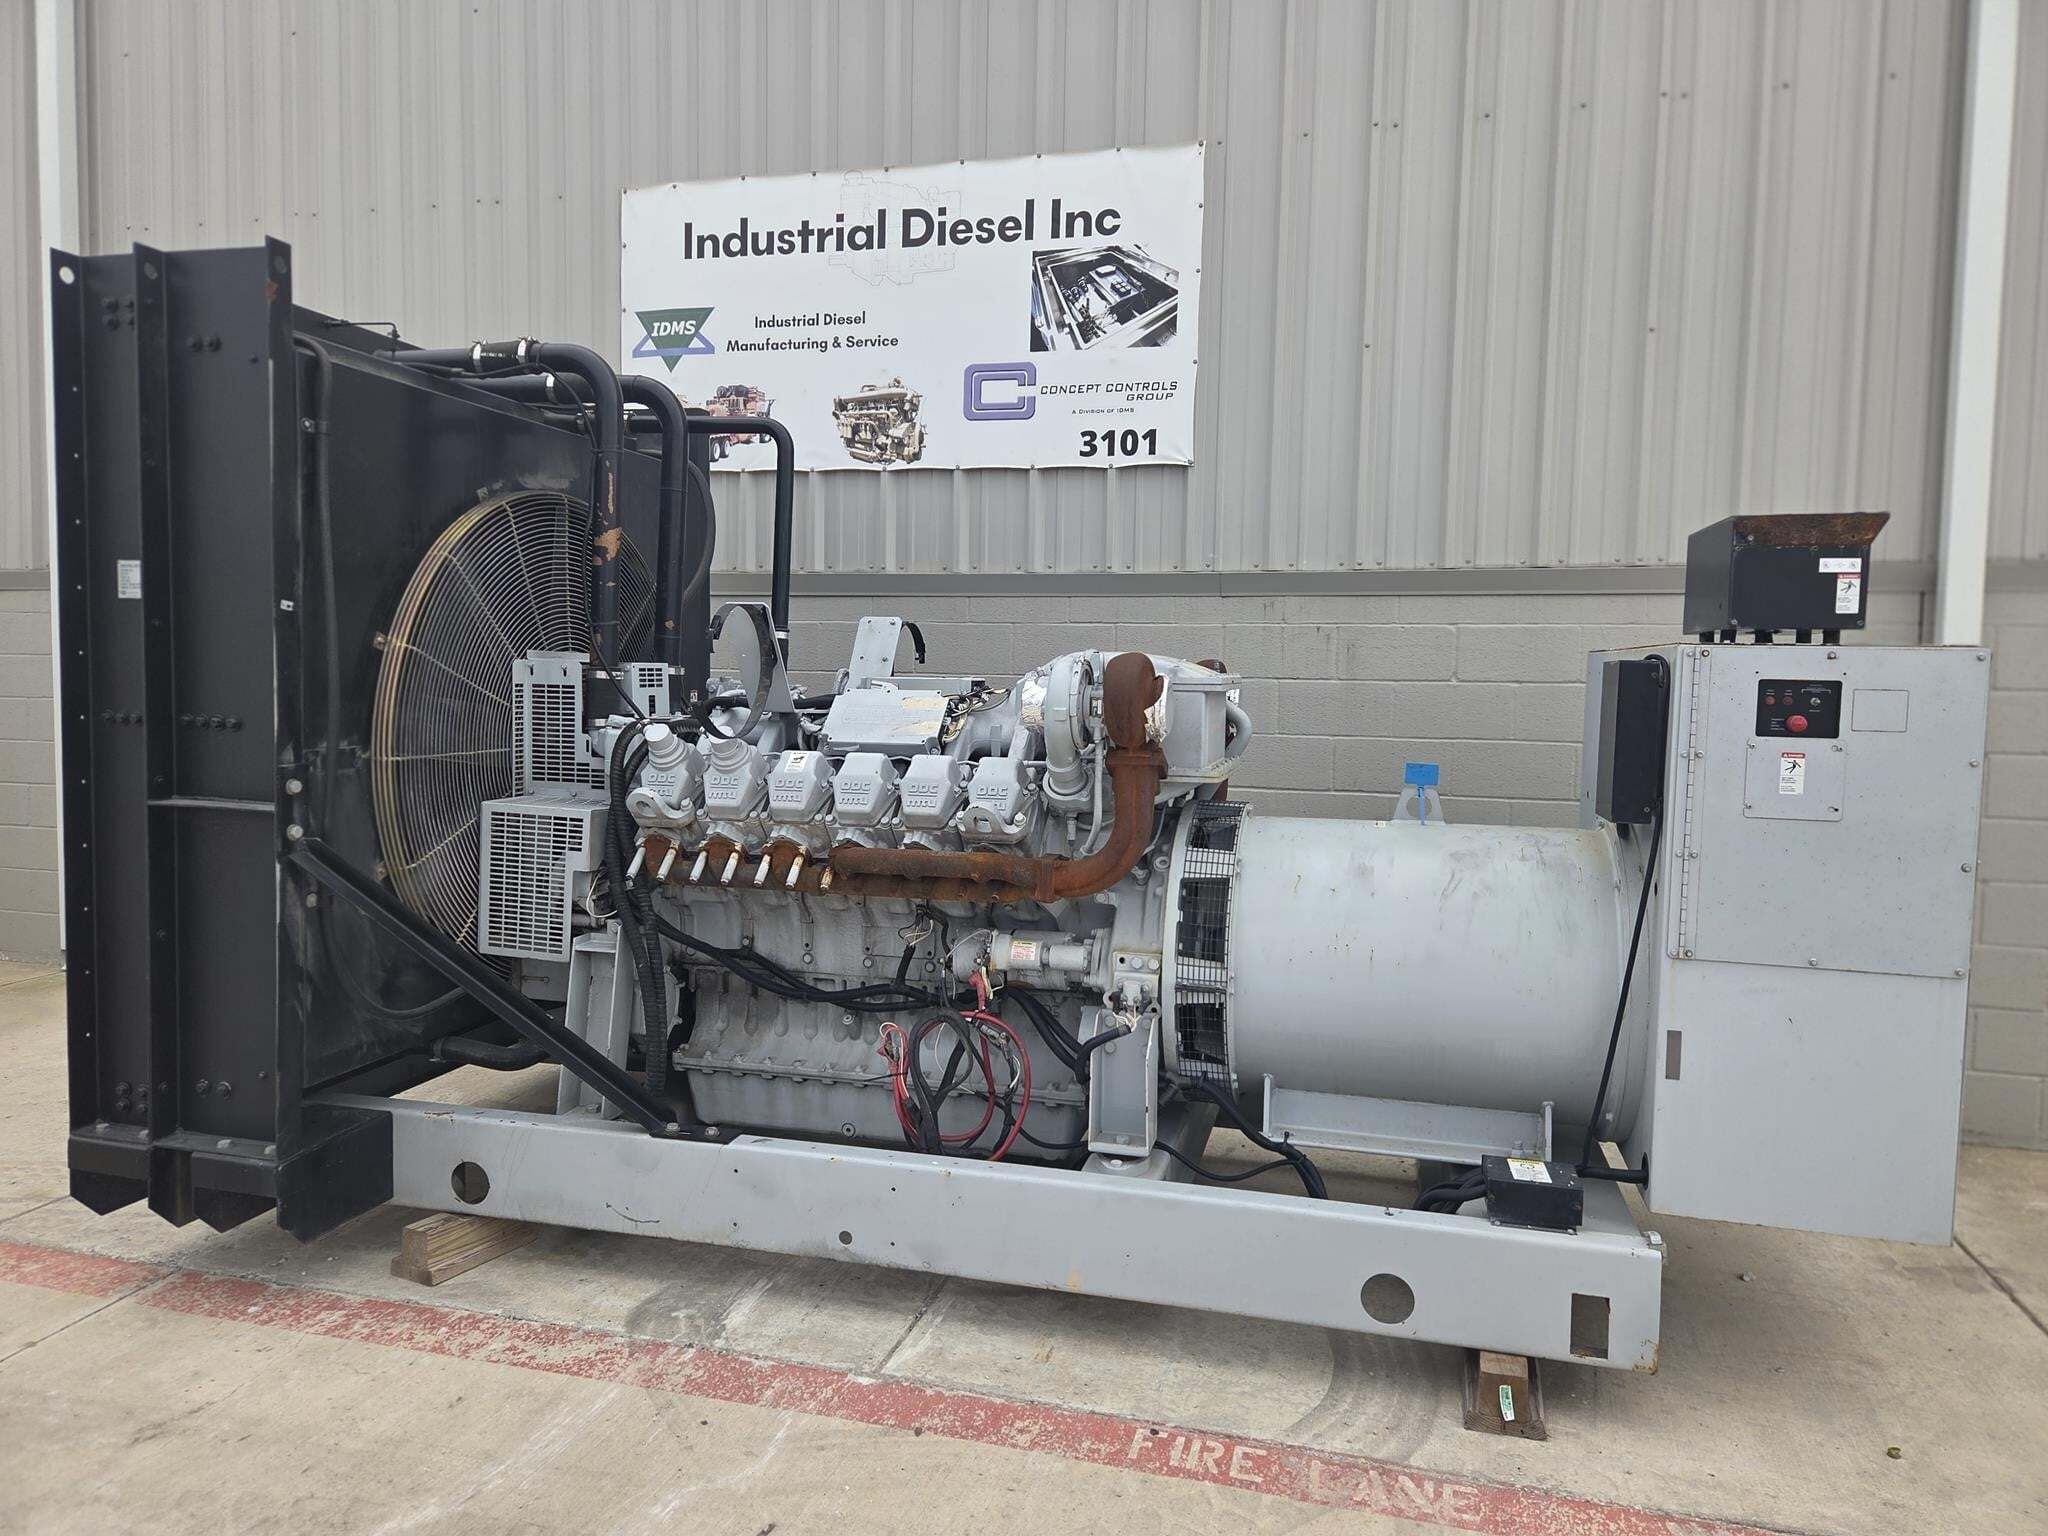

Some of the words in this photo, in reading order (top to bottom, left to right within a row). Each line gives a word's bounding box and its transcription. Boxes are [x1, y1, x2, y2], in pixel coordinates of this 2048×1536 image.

[684, 208, 887, 259] Industrial
[902, 199, 1035, 248] Diesel
[1050, 198, 1121, 239] Inc
[651, 319, 697, 337] IDMS
[754, 312, 820, 328] Industrial
[823, 310, 866, 326] Diesel
[726, 336, 829, 353] Manufacturing
[832, 336, 842, 348] &
[845, 334, 899, 348] Service
[1040, 383, 1102, 395] CONCEPT
[1105, 380, 1178, 393] CONTROLS
[1126, 392, 1174, 402] GROUP
[1079, 428, 1157, 458] 3101
[1127, 1428, 1268, 1483] FIRE
[1302, 1459, 1482, 1523] LANE
